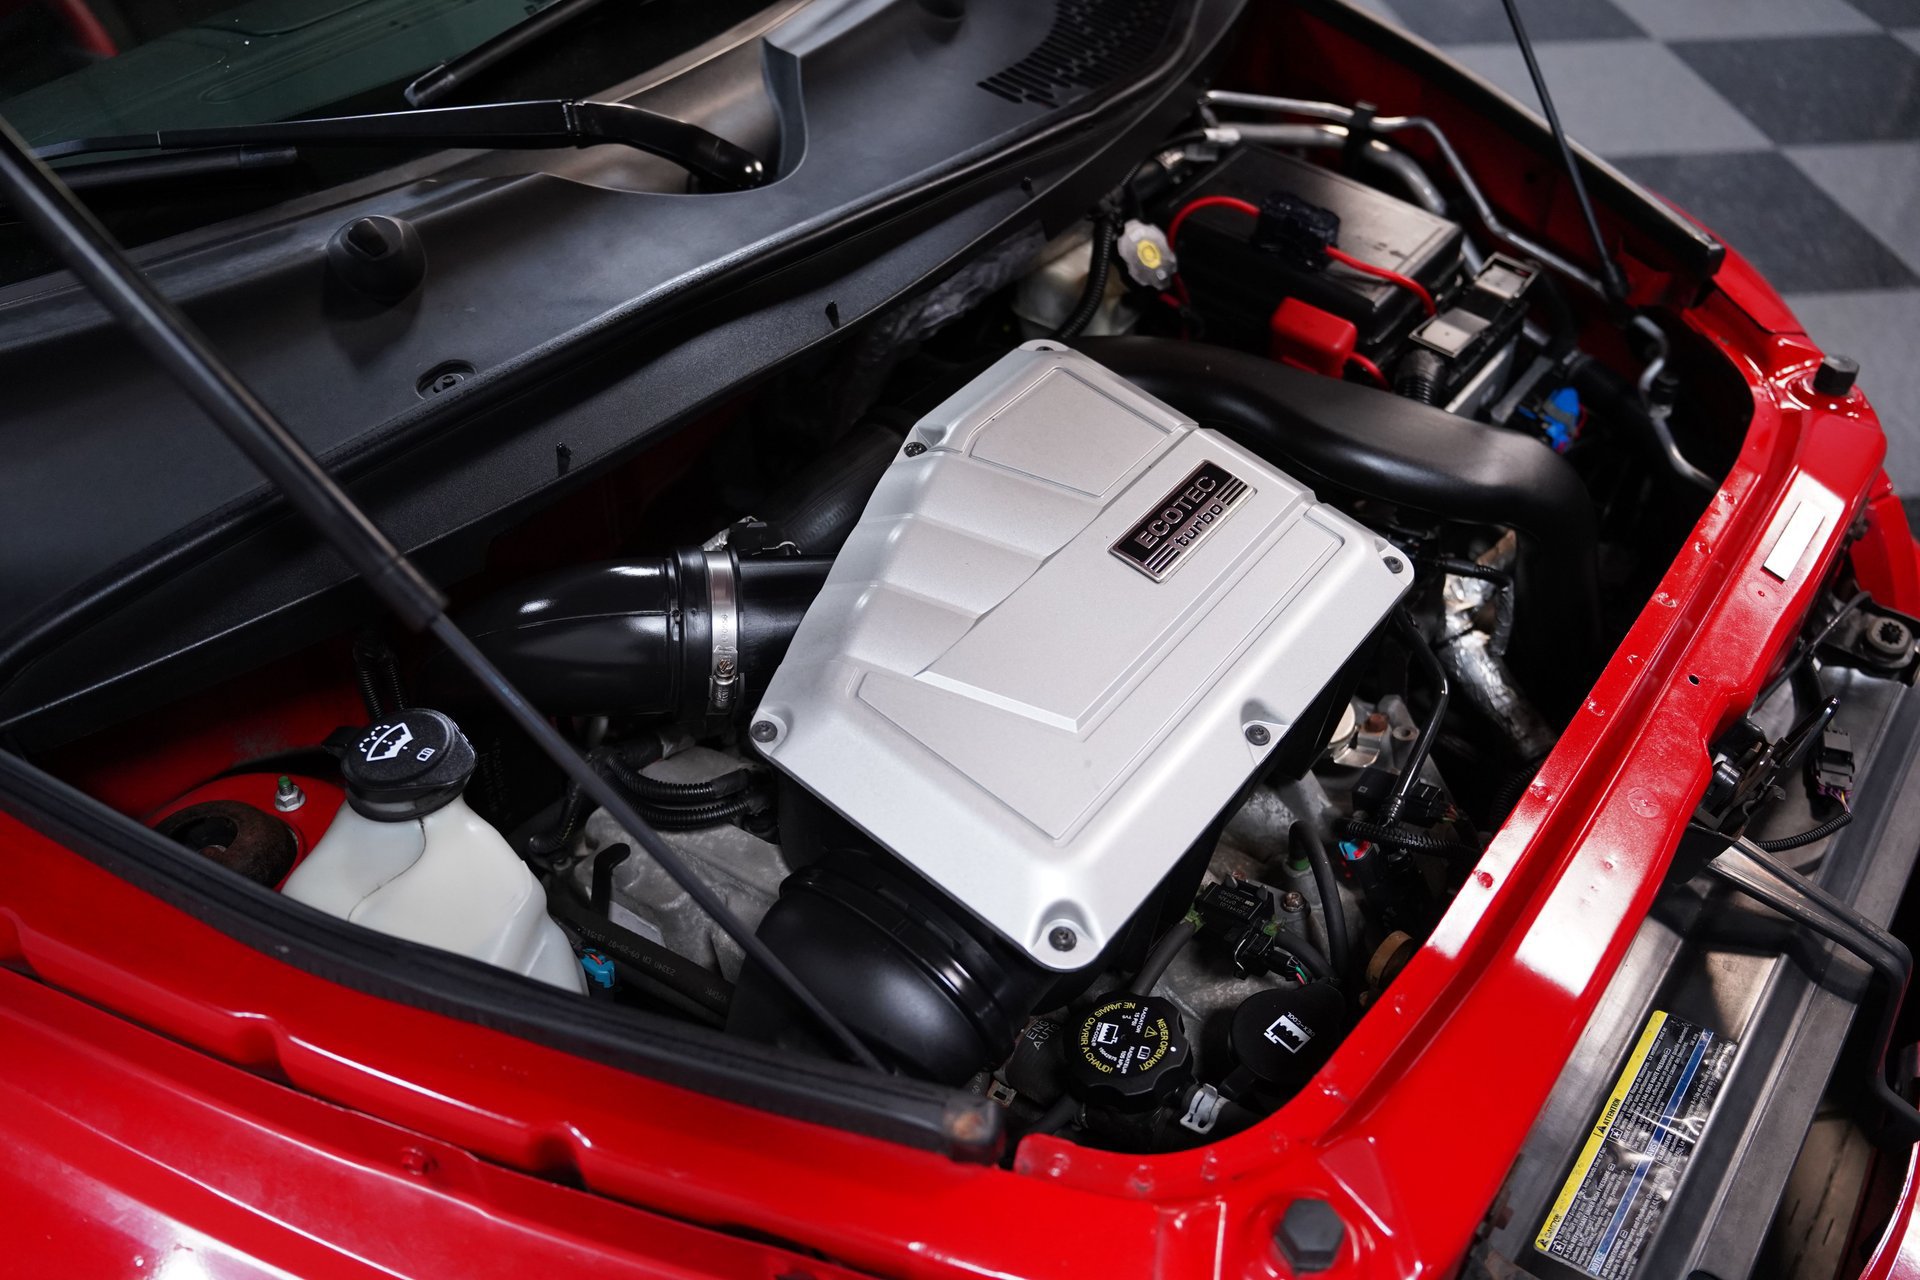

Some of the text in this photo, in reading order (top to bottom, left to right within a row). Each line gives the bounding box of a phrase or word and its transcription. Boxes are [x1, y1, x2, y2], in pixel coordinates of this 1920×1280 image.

[1134, 476, 1217, 550] ECOTEC
[1175, 503, 1224, 548] turbo
[1094, 1002, 1122, 1017] JAMAIS
[1135, 1006, 1148, 1033] RADIATOR
[1026, 1020, 1049, 1040] ENG
[1080, 1017, 1095, 1045] OUVRIR
[1139, 1018, 1168, 1070] NEVER OPEN HOT!
[1085, 1052, 1113, 1073] CHAUD!
[1121, 1045, 1134, 1073] RADIATEUR
[1601, 1096, 1621, 1126] ATTENTION
[1646, 1142, 1658, 1156] AVIS
[1589, 1250, 1605, 1272] NOTICE
